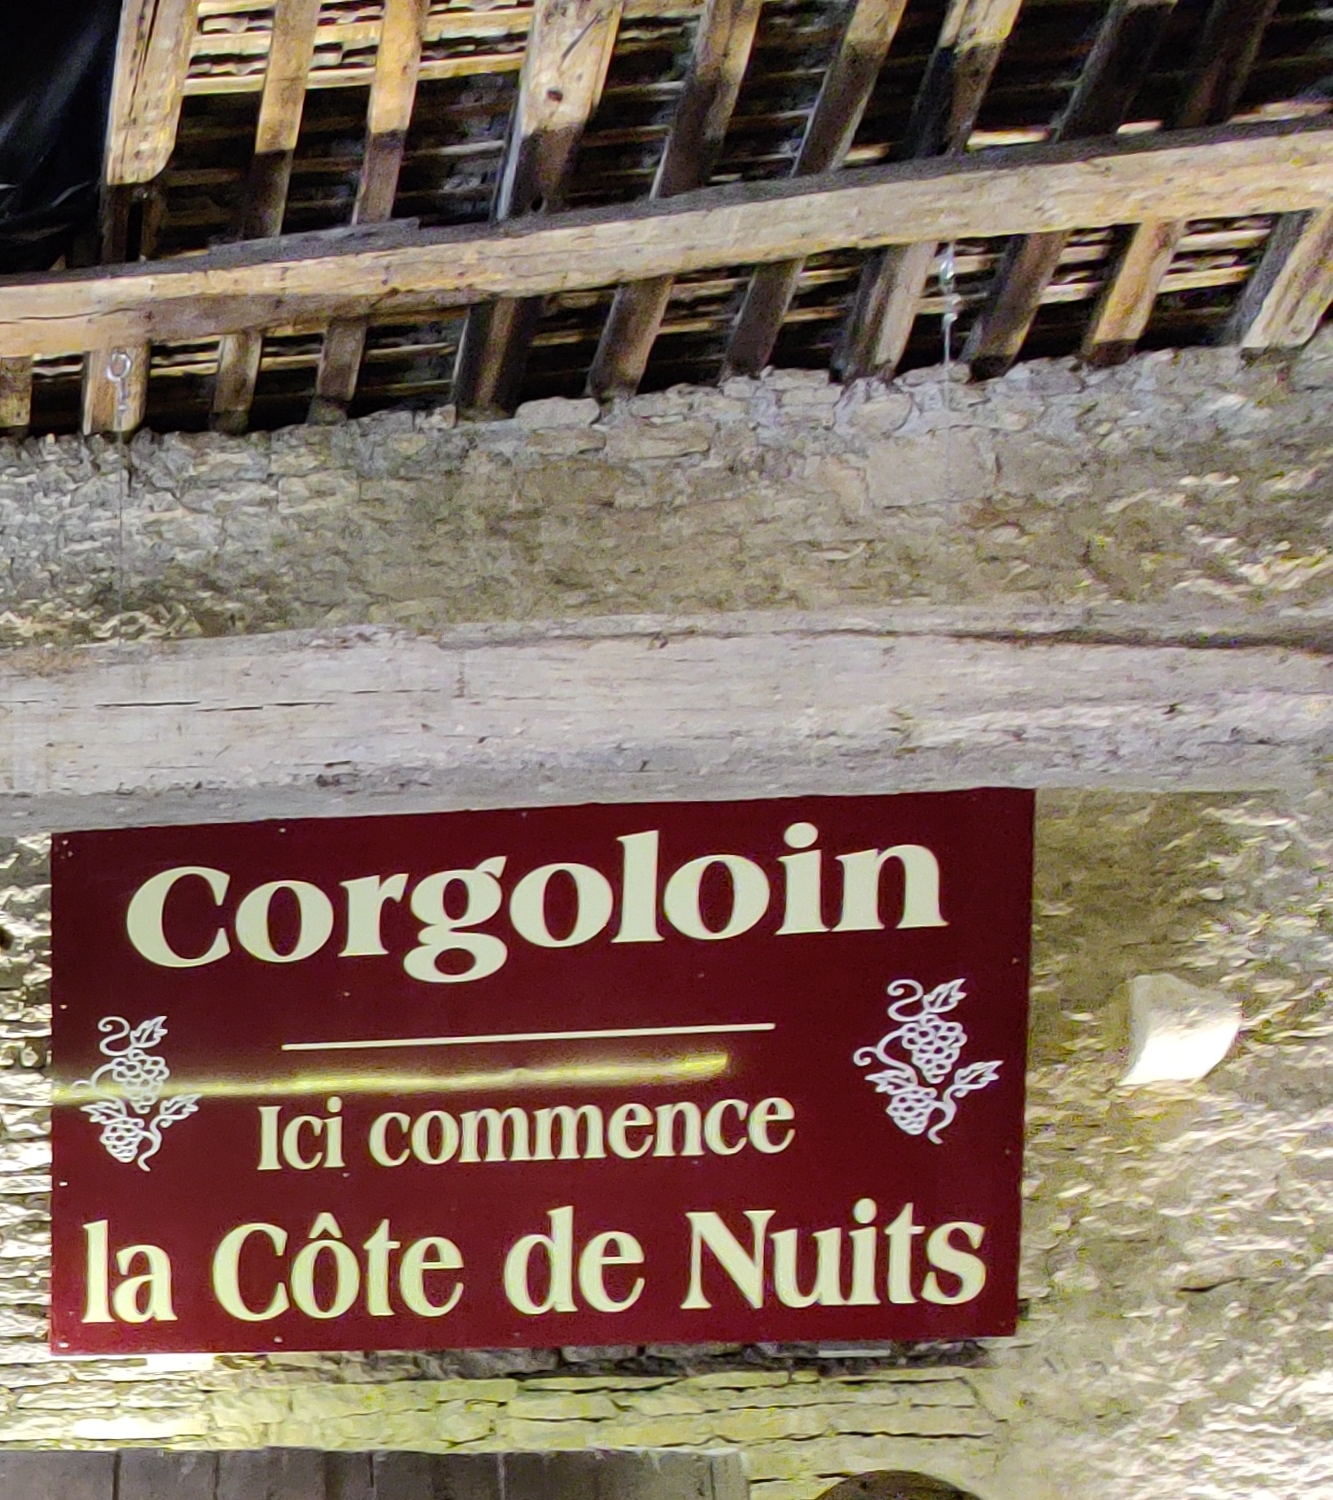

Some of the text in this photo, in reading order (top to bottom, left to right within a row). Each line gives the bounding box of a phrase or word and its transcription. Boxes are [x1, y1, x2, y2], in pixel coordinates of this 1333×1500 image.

[126, 822, 948, 983] Corgoloin
[257, 1096, 796, 1171] Ici commence
[80, 1198, 986, 1324] la Côte de Nuits
